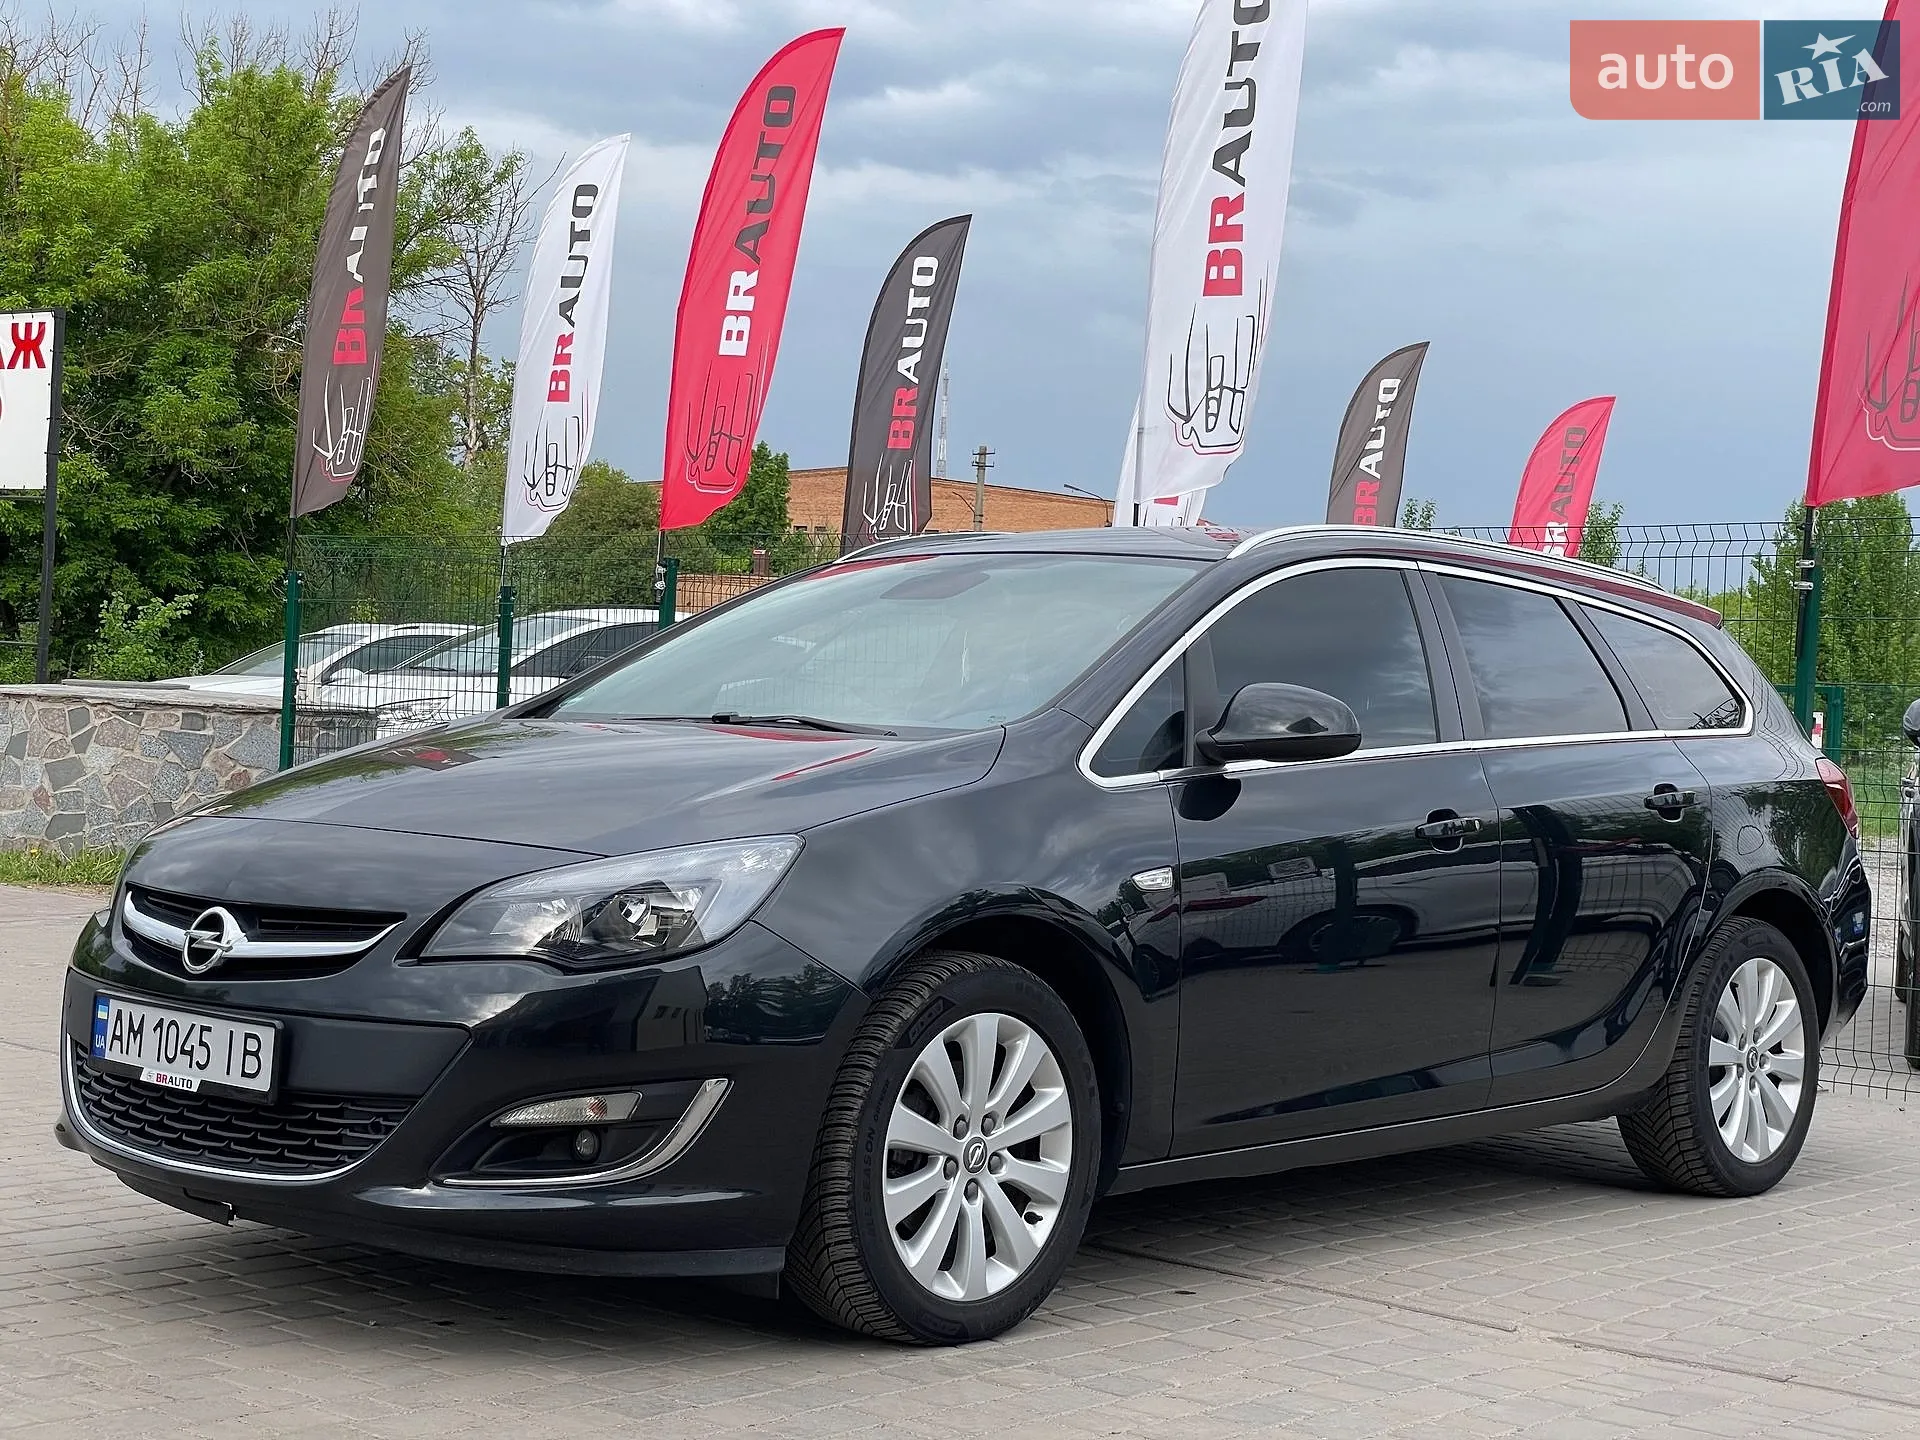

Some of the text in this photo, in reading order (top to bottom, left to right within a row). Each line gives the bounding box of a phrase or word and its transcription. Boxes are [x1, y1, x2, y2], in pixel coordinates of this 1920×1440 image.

[718, 84, 797, 357] BRAUTO
[0, 322, 46, 370] Ж
[547, 184, 599, 402] BRAUTO
[887, 256, 939, 449] BRAUTO
[1353, 378, 1401, 526] BRAUTO
[95, 1035, 106, 1049] UA
[109, 1008, 262, 1079] AM 1045 IB
[155, 1072, 193, 1089] BRAUTO
